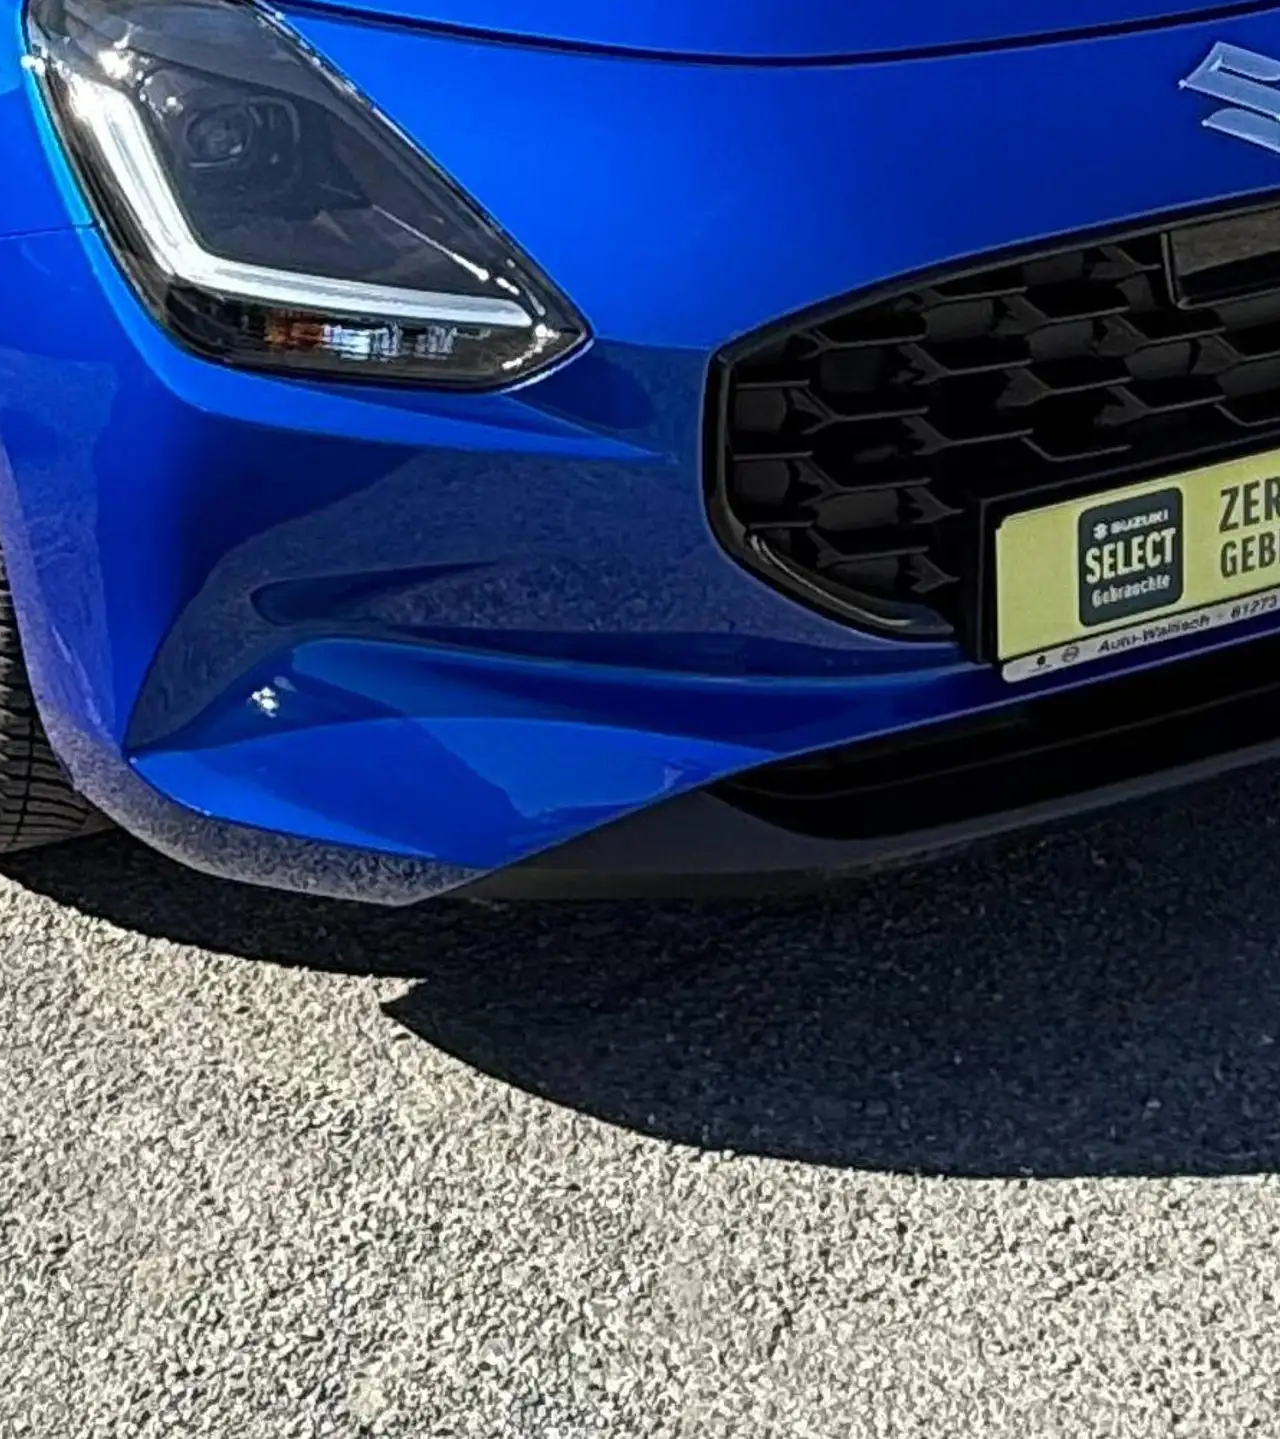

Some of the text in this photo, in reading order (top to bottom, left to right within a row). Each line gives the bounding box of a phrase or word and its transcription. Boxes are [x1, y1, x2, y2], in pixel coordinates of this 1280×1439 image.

[1110, 509, 1168, 534] SUZUKI
[1085, 527, 1176, 585] SELECT
[1092, 574, 1171, 608] Gebrauchte
